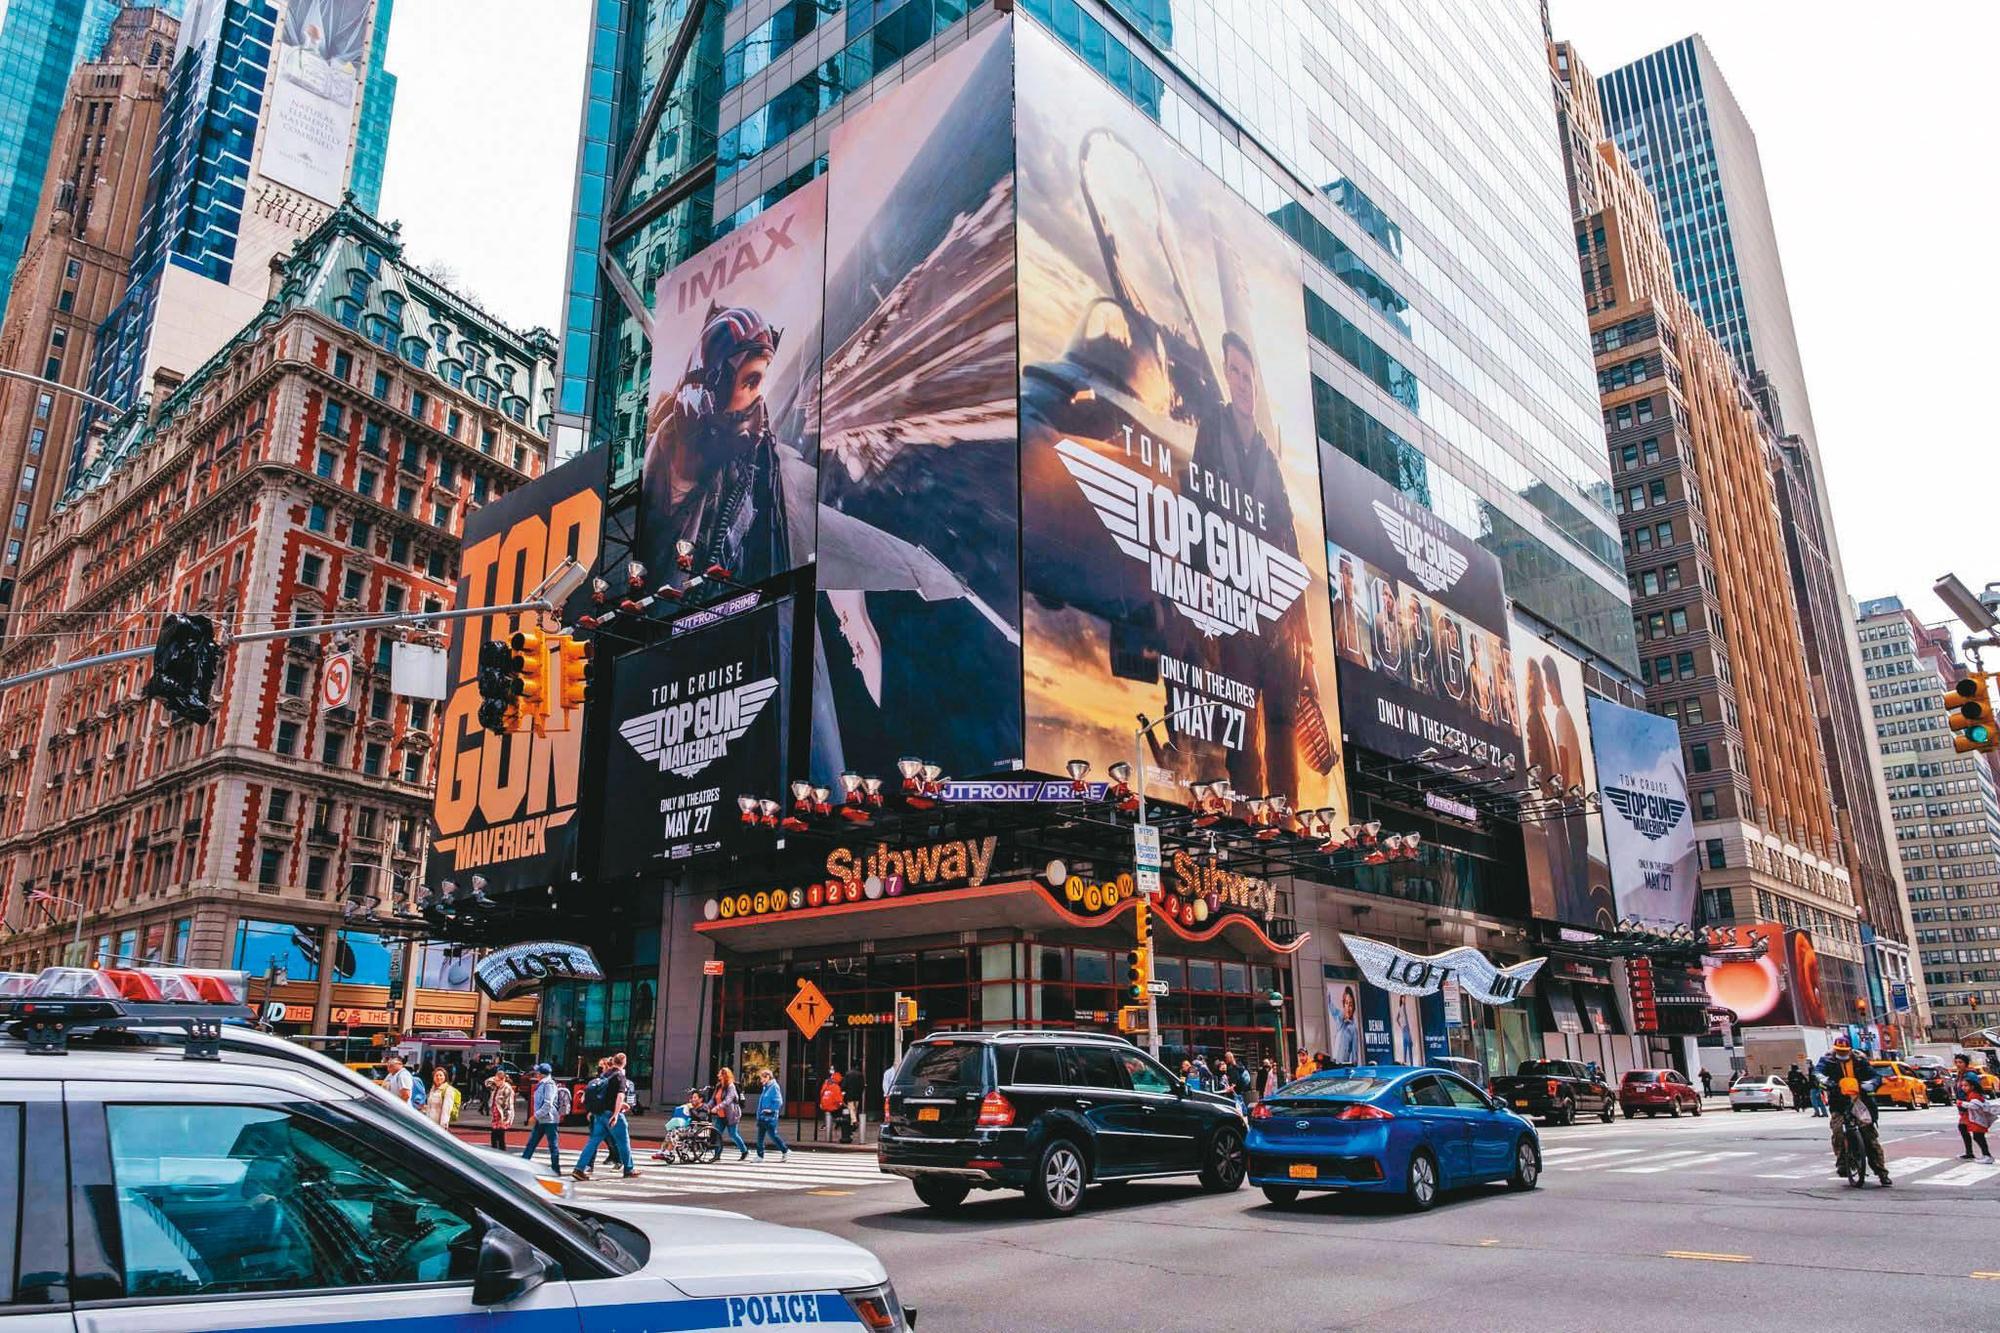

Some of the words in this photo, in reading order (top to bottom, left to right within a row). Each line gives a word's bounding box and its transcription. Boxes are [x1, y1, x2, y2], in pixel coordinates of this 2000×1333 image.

[678, 213, 796, 315] IMAX
[1122, 424, 1173, 479] TOM
[1190, 461, 1268, 531] CRUISE
[1392, 492, 1412, 516] TOM
[1135, 478, 1203, 567] TOP
[1204, 510, 1271, 604] GUN
[1400, 518, 1424, 560] TOP
[1424, 531, 1451, 577] GUN
[729, 593, 757, 612] PRIME
[1149, 549, 1261, 637] MAVERICK
[652, 681, 679, 706] TOM
[688, 661, 743, 695] CRUISE
[1161, 654, 1188, 685] ONLY
[1191, 665, 1203, 691] IN
[1205, 670, 1256, 709] THEATRES
[652, 701, 694, 750] TOP
[694, 689, 740, 738] GUN
[1173, 686, 1216, 742] MAY
[1221, 704, 1246, 752] 27
[1377, 697, 1404, 730] ONLY
[1407, 709, 1420, 736] IN
[1489, 744, 1500, 768] 27
[658, 733, 728, 772] MAVERICK
[928, 784, 1035, 799] UTFRONT
[1619, 774, 1636, 786] TOM
[660, 797, 677, 813] ONLY
[677, 794, 686, 809] IN
[686, 787, 720, 807] THEATRES
[1626, 790, 1647, 817] TOP
[1647, 794, 1672, 822] GUN
[665, 809, 692, 840] MAY
[693, 805, 712, 834] 27
[1632, 817, 1670, 836] MAVERICK
[453, 815, 548, 872] MAVERICK
[825, 835, 998, 887] Subway
[723, 902, 732, 914] N
[739, 899, 749, 913] Q
[757, 898, 766, 911] R
[774, 895, 785, 909] W
[792, 890, 800, 905] S
[830, 886, 838, 900] 2
[849, 882, 857, 898] 3
[889, 876, 898, 893] 7
[1174, 850, 1277, 921] Subway
[1643, 871, 1660, 890] MAY
[1661, 873, 1672, 891] 27
[1072, 880, 1082, 896] N
[1091, 889, 1099, 906] Q
[1109, 885, 1116, 901] R
[1123, 879, 1132, 893] W
[1171, 899, 1178, 912] 2
[1186, 907, 1193, 920] 3
[1212, 894, 1218, 907] 7
[507, 952, 576, 980] LOFT
[1386, 955, 1456, 989] LOFT
[288, 1008, 311, 1019] THE
[368, 1012, 386, 1023] THE
[434, 1013, 444, 1024] IS
[445, 1014, 455, 1025] IN
[1368, 1019, 1384, 1032] DENIM
[1365, 1032, 1379, 1045] WITH
[1378, 1033, 1391, 1046] LOVE
[729, 1294, 819, 1327] POLICE
